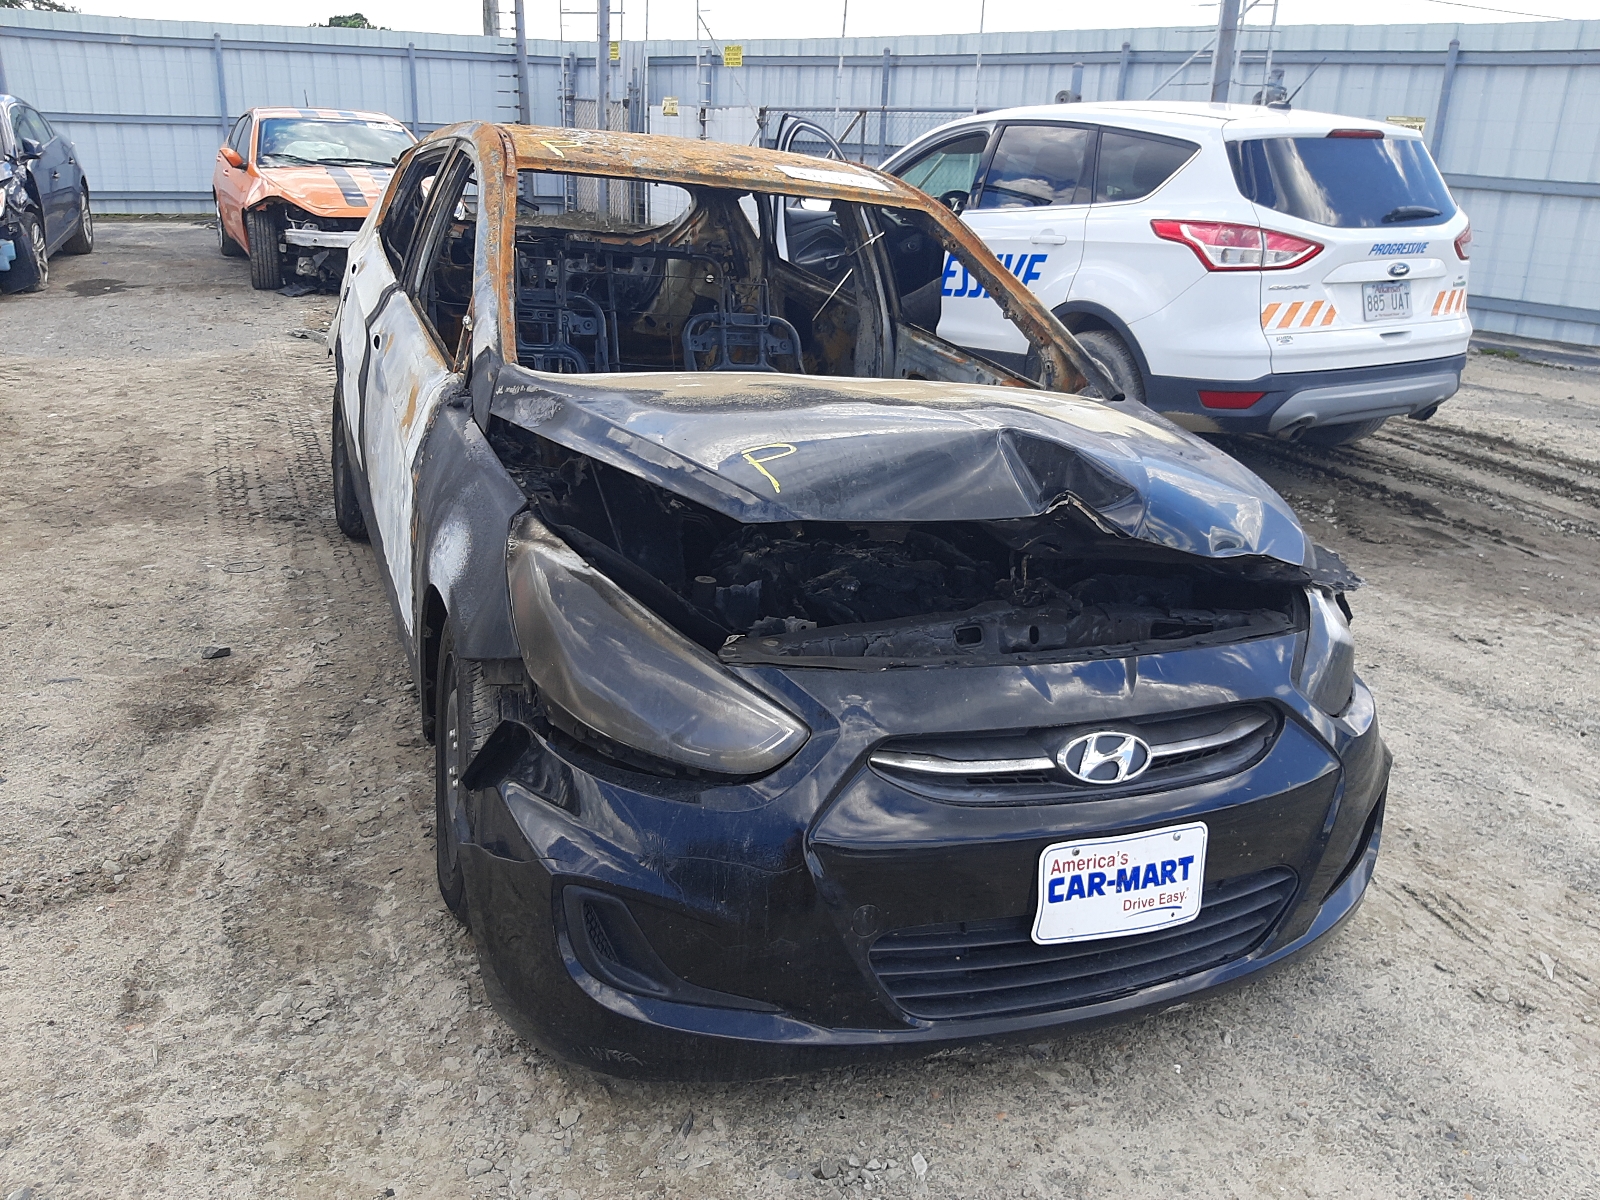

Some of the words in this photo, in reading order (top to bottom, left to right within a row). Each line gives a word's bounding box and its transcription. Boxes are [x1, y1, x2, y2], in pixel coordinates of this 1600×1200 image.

[1368, 242, 1429, 255] PROGRESSIVE
[941, 253, 1048, 298] ESSVE
[1367, 294, 1385, 312] 885
[1391, 293, 1409, 310] UAT
[741, 442, 797, 493] P
[1050, 851, 1129, 875] America's
[1048, 855, 1194, 904] CAR-MART
[1123, 896, 1155, 911] Drive
